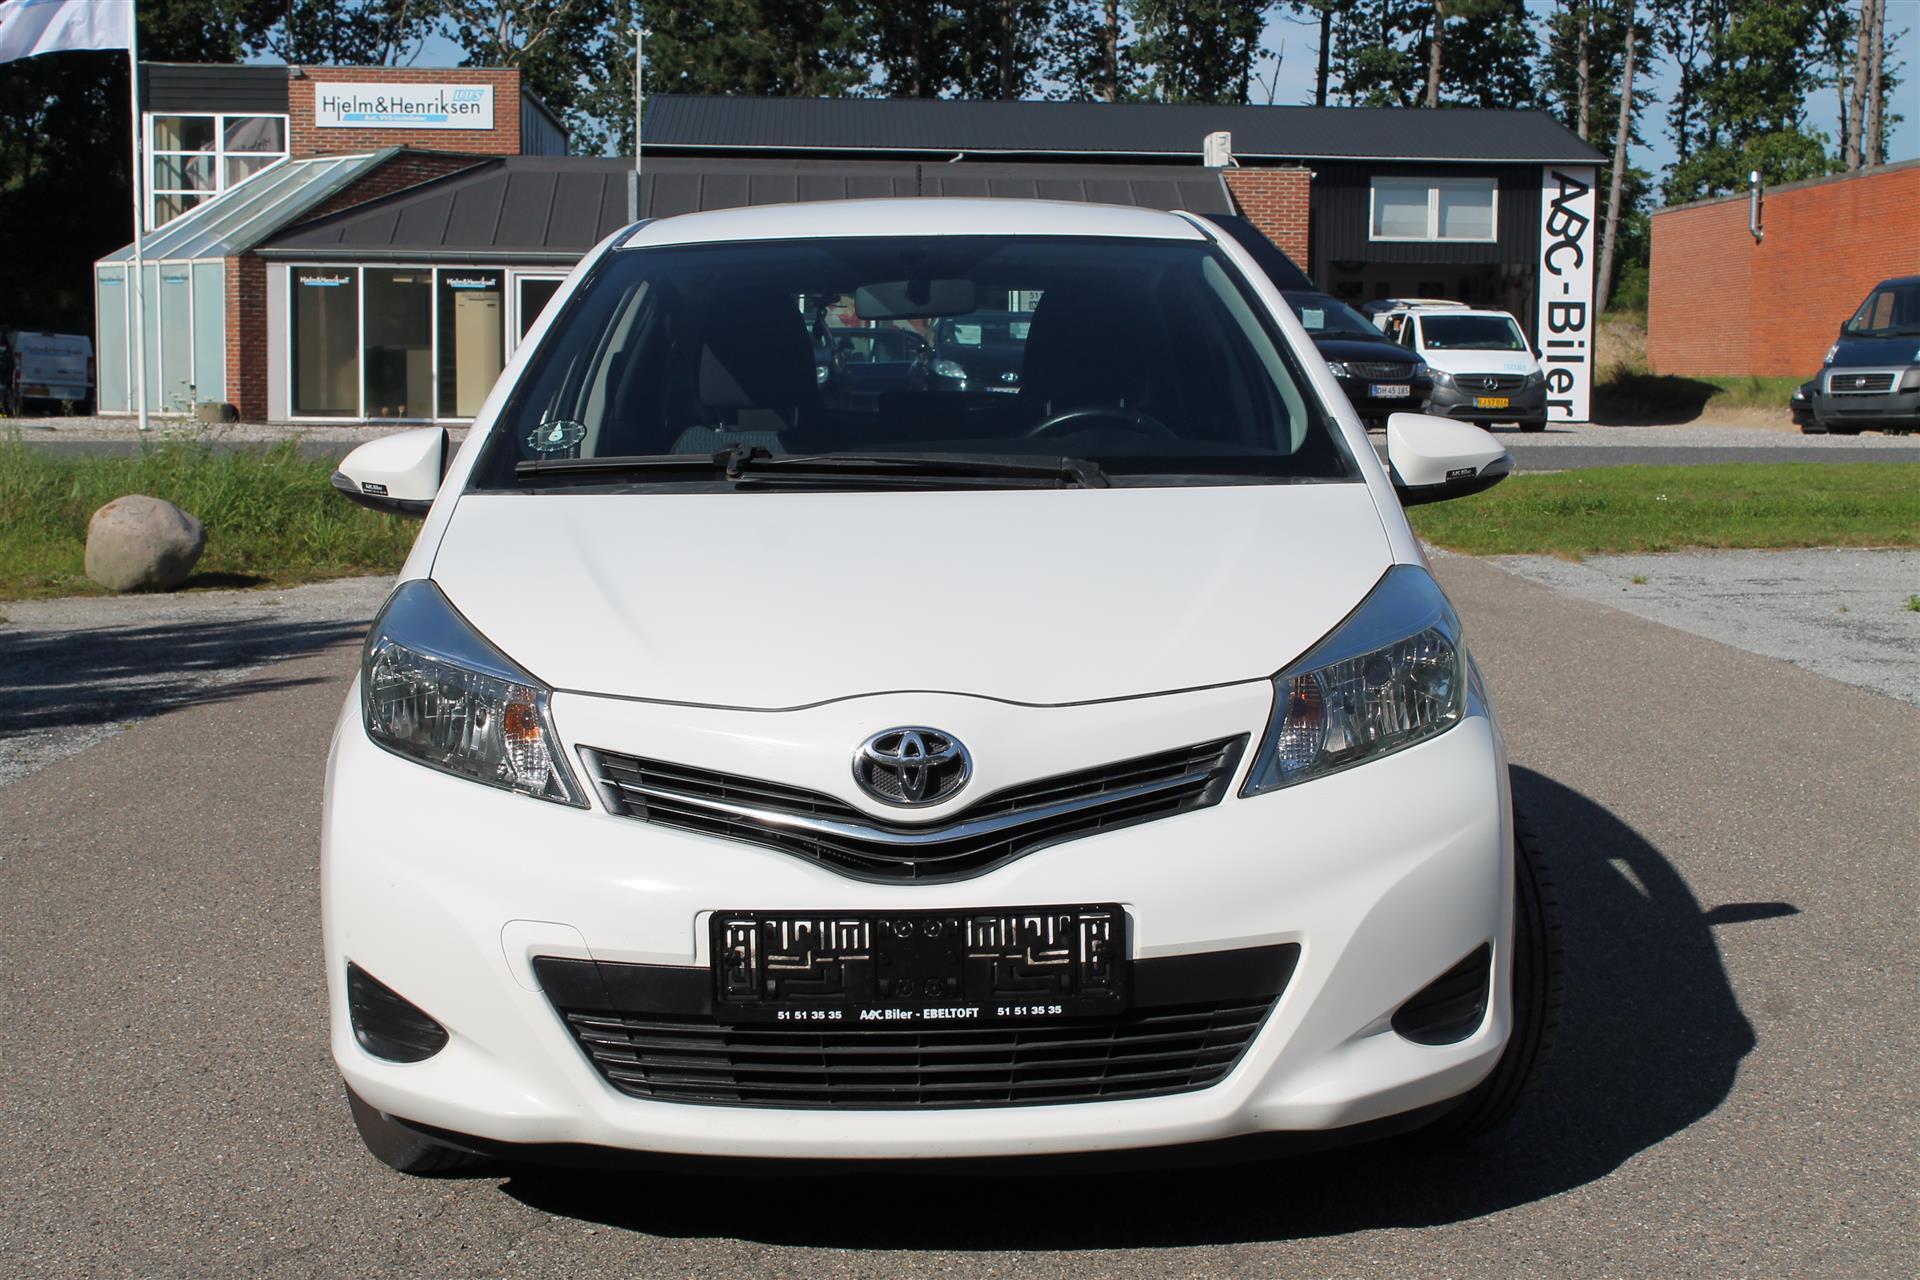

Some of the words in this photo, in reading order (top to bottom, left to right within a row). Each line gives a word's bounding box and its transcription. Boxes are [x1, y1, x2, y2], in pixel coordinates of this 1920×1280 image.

[323, 90, 480, 121] Hjelm&Henriksen
[1544, 170, 1590, 418] ABC-Biler
[777, 1011, 790, 1020] 51
[794, 1011, 807, 1020] 51
[811, 1011, 825, 1020] 35
[828, 1011, 842, 1020] 35
[884, 1009, 913, 1020] Biler
[923, 1008, 979, 1019] EBELTOFT
[997, 1007, 1010, 1016] 51
[1014, 1006, 1027, 1015] 51
[1031, 1006, 1045, 1014] 35
[1048, 1005, 1062, 1014] 35
